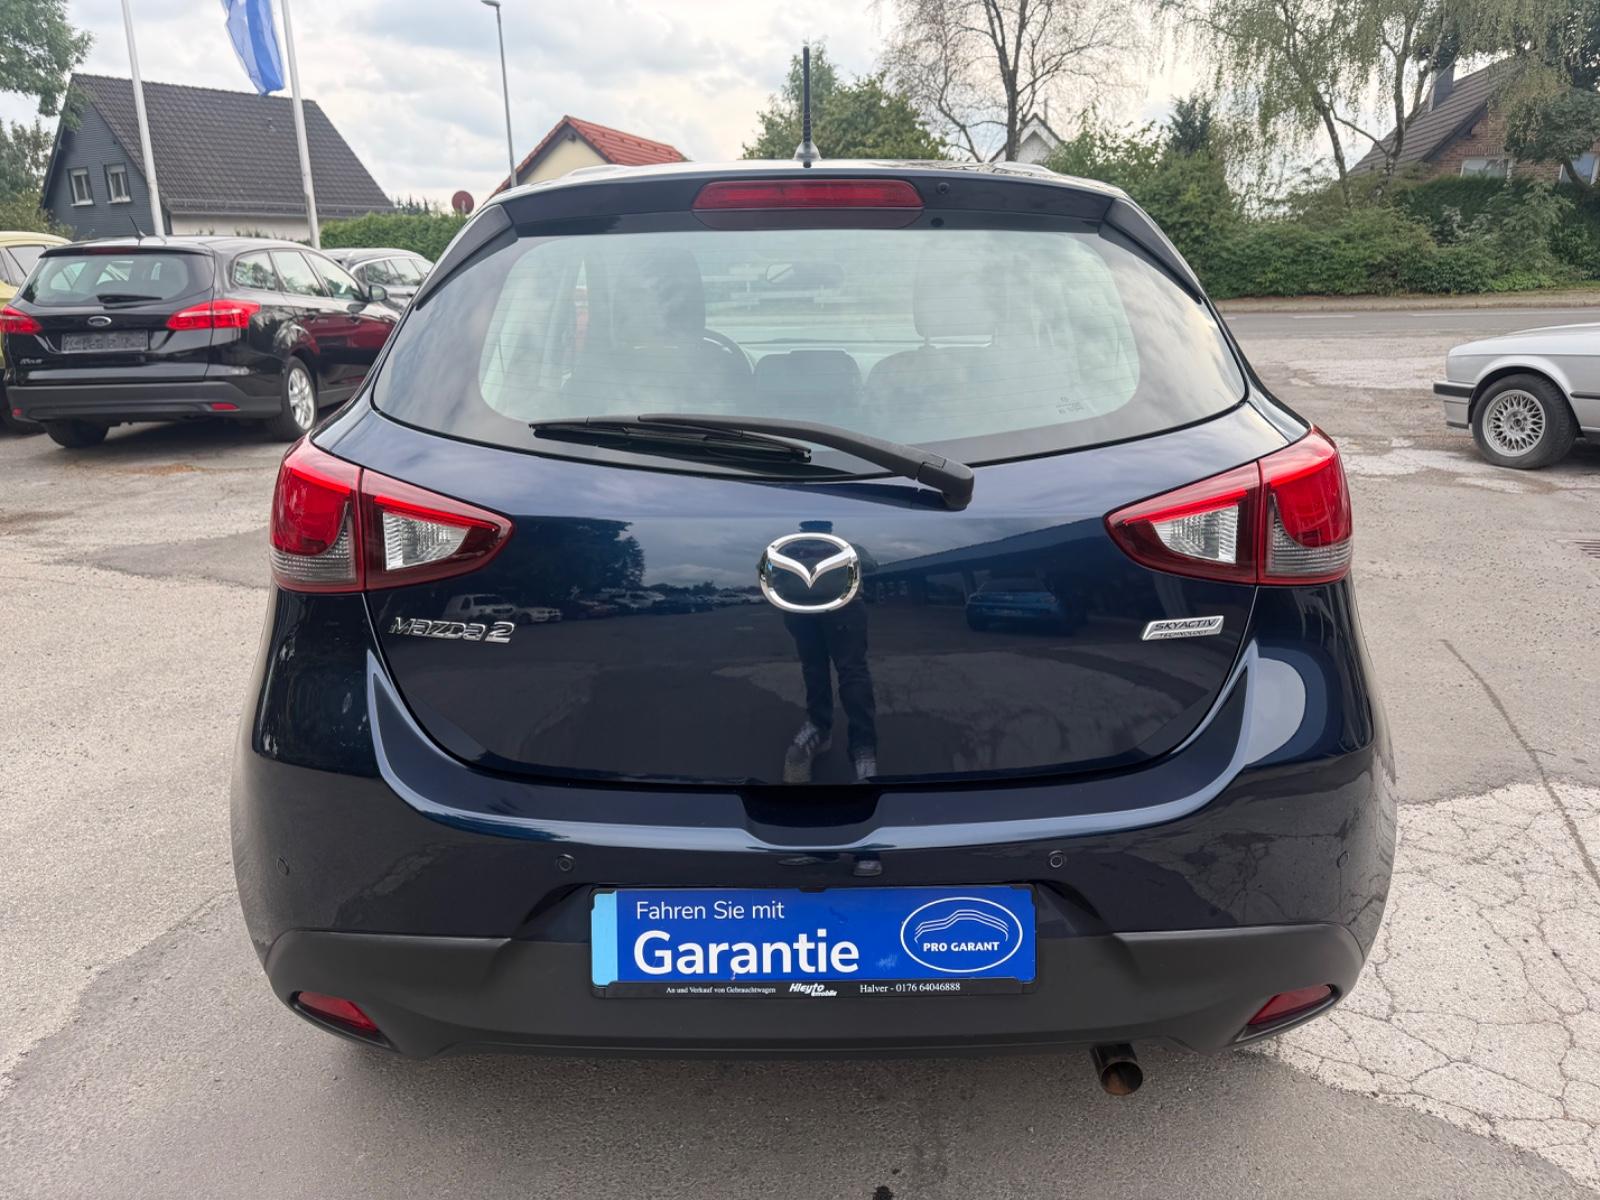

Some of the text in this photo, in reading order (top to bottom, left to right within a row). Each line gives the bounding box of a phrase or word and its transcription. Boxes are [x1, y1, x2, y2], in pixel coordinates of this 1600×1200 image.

[1155, 619, 1216, 631] SKYACTIV
[636, 900, 785, 920] Fahren Sie mit
[633, 928, 860, 975] Garantie
[923, 941, 1000, 952] PRO GARANT
[689, 986, 713, 994] Verkauf
[726, 986, 776, 995] Gebrauchtwagen
[859, 984, 889, 993] Halver
[895, 983, 918, 992] 0176
[919, 982, 961, 992] 64046888
